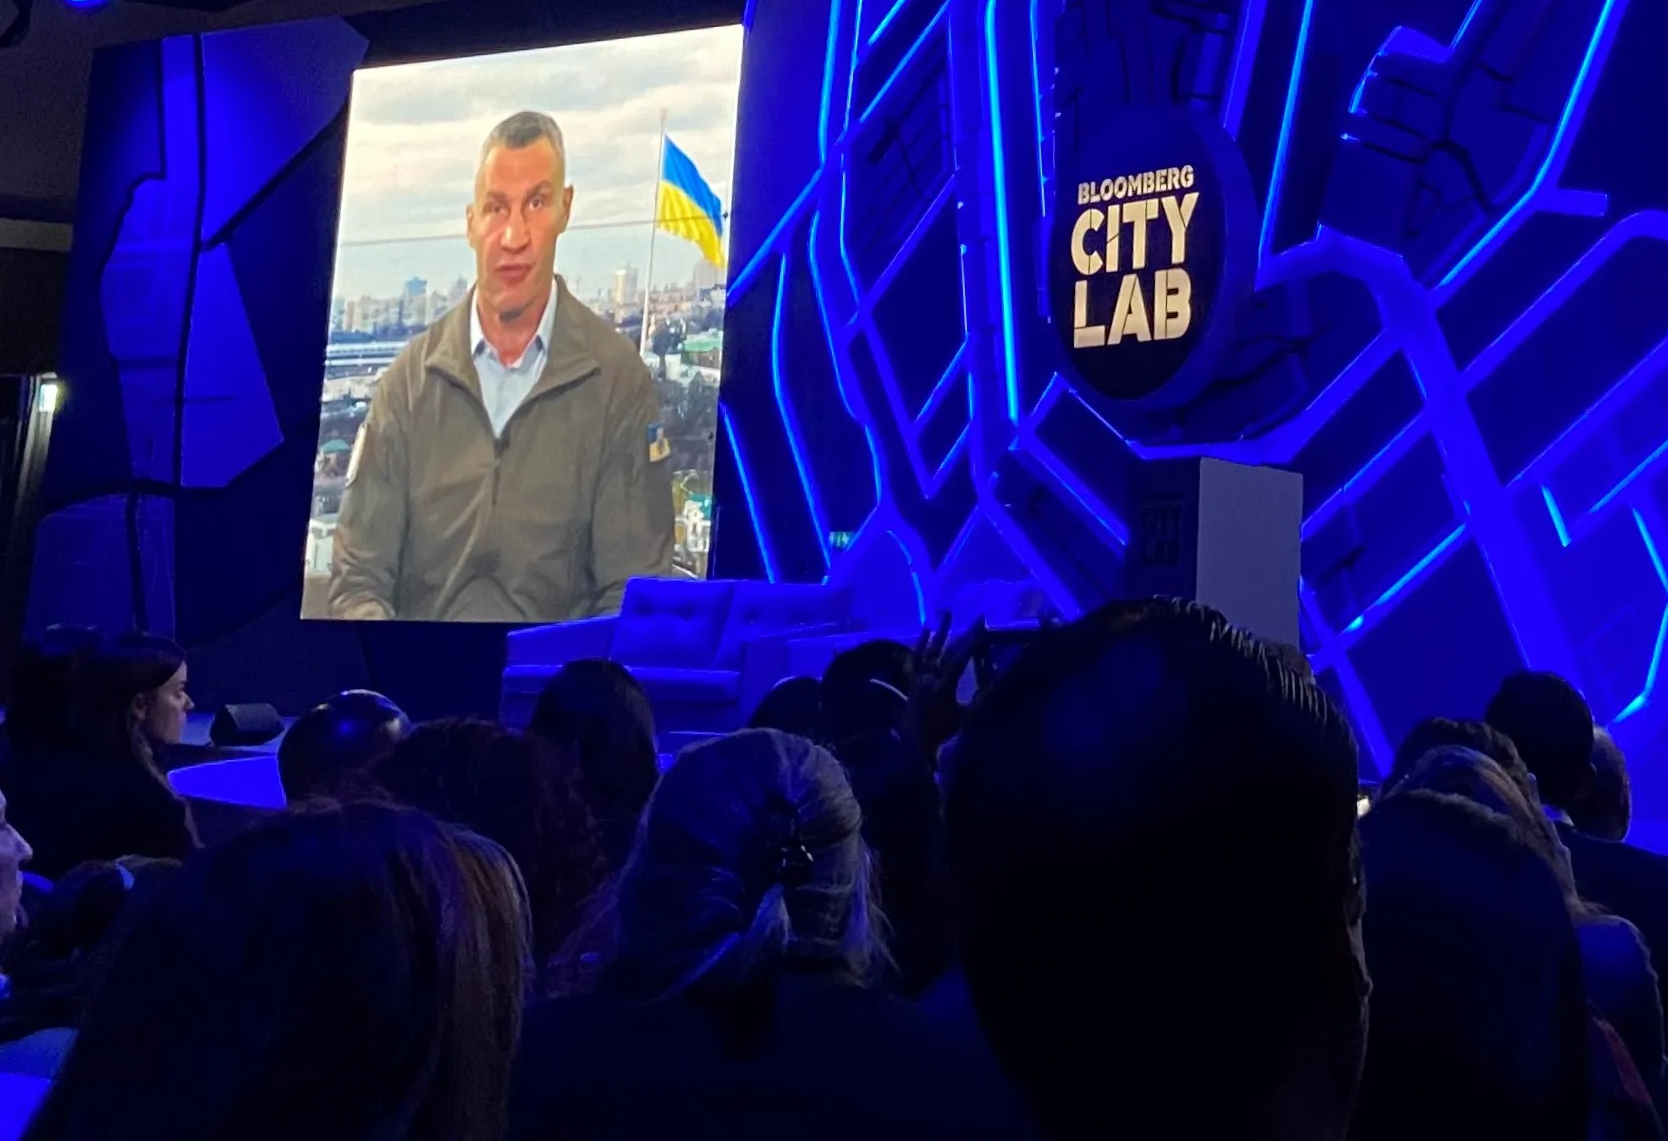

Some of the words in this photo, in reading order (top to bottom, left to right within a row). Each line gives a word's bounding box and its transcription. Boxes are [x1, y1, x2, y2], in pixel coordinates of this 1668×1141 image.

[1077, 164, 1195, 205] BLOOMBERG
[1071, 192, 1200, 276] CITY
[1073, 268, 1192, 349] LAB
